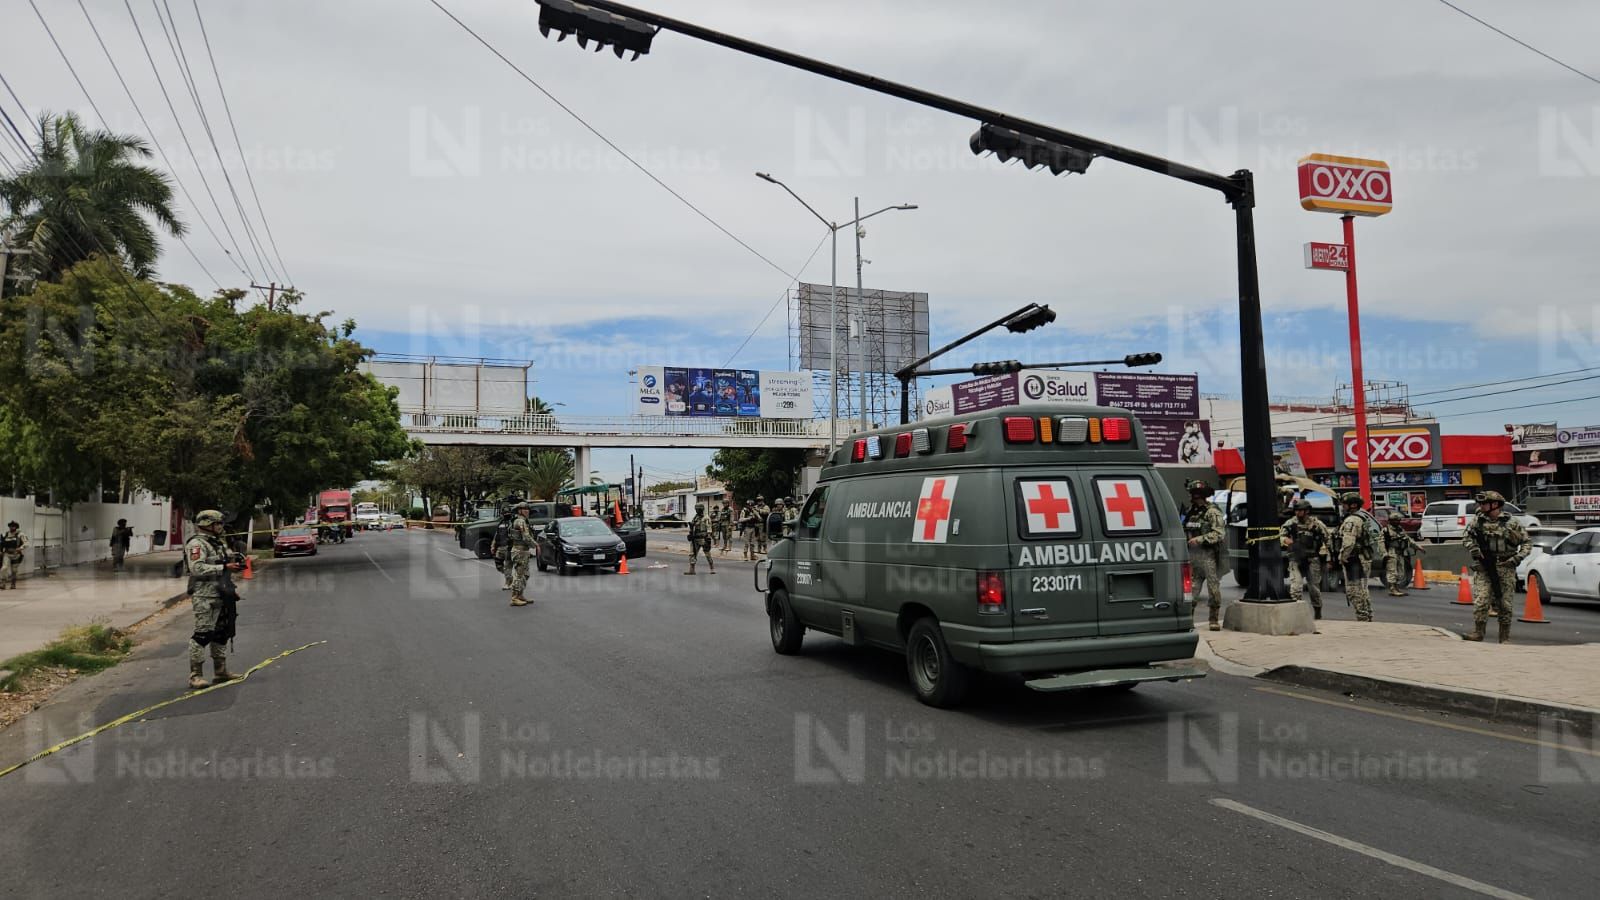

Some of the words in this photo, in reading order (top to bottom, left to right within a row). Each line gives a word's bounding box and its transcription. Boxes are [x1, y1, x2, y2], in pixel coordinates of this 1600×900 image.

[1313, 167, 1389, 200] OXXO
[1329, 246, 1347, 260] 24
[1047, 381, 1087, 396] Salud
[934, 400, 950, 412] Salud
[847, 501, 911, 518] AMBULANCIA
[1018, 541, 1168, 566] AMBULANCIA
[1032, 574, 1082, 593] 2330171
